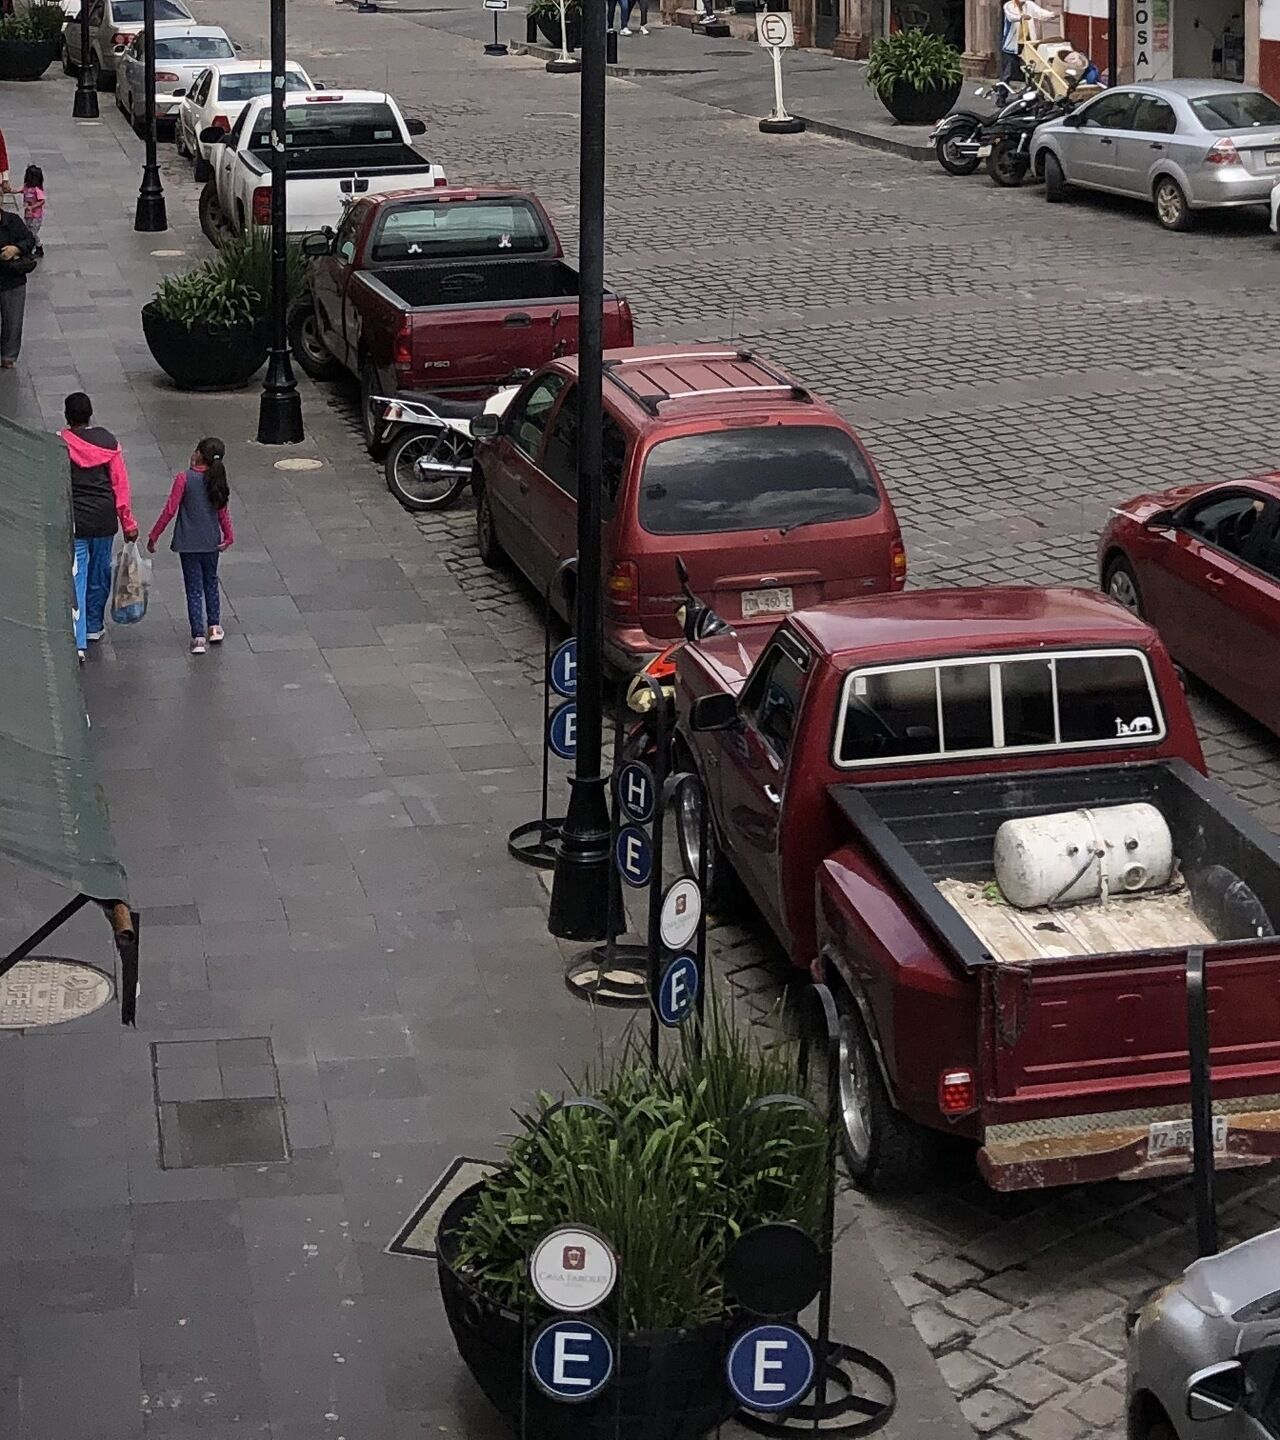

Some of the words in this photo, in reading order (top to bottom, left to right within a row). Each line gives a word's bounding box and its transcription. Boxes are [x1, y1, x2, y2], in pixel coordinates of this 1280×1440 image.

[766, 20, 782, 39] E
[628, 772, 646, 807] H
[626, 835, 642, 875] E
[671, 967, 687, 1012] E
[552, 1331, 591, 1387] E
[753, 1339, 788, 1391] E
